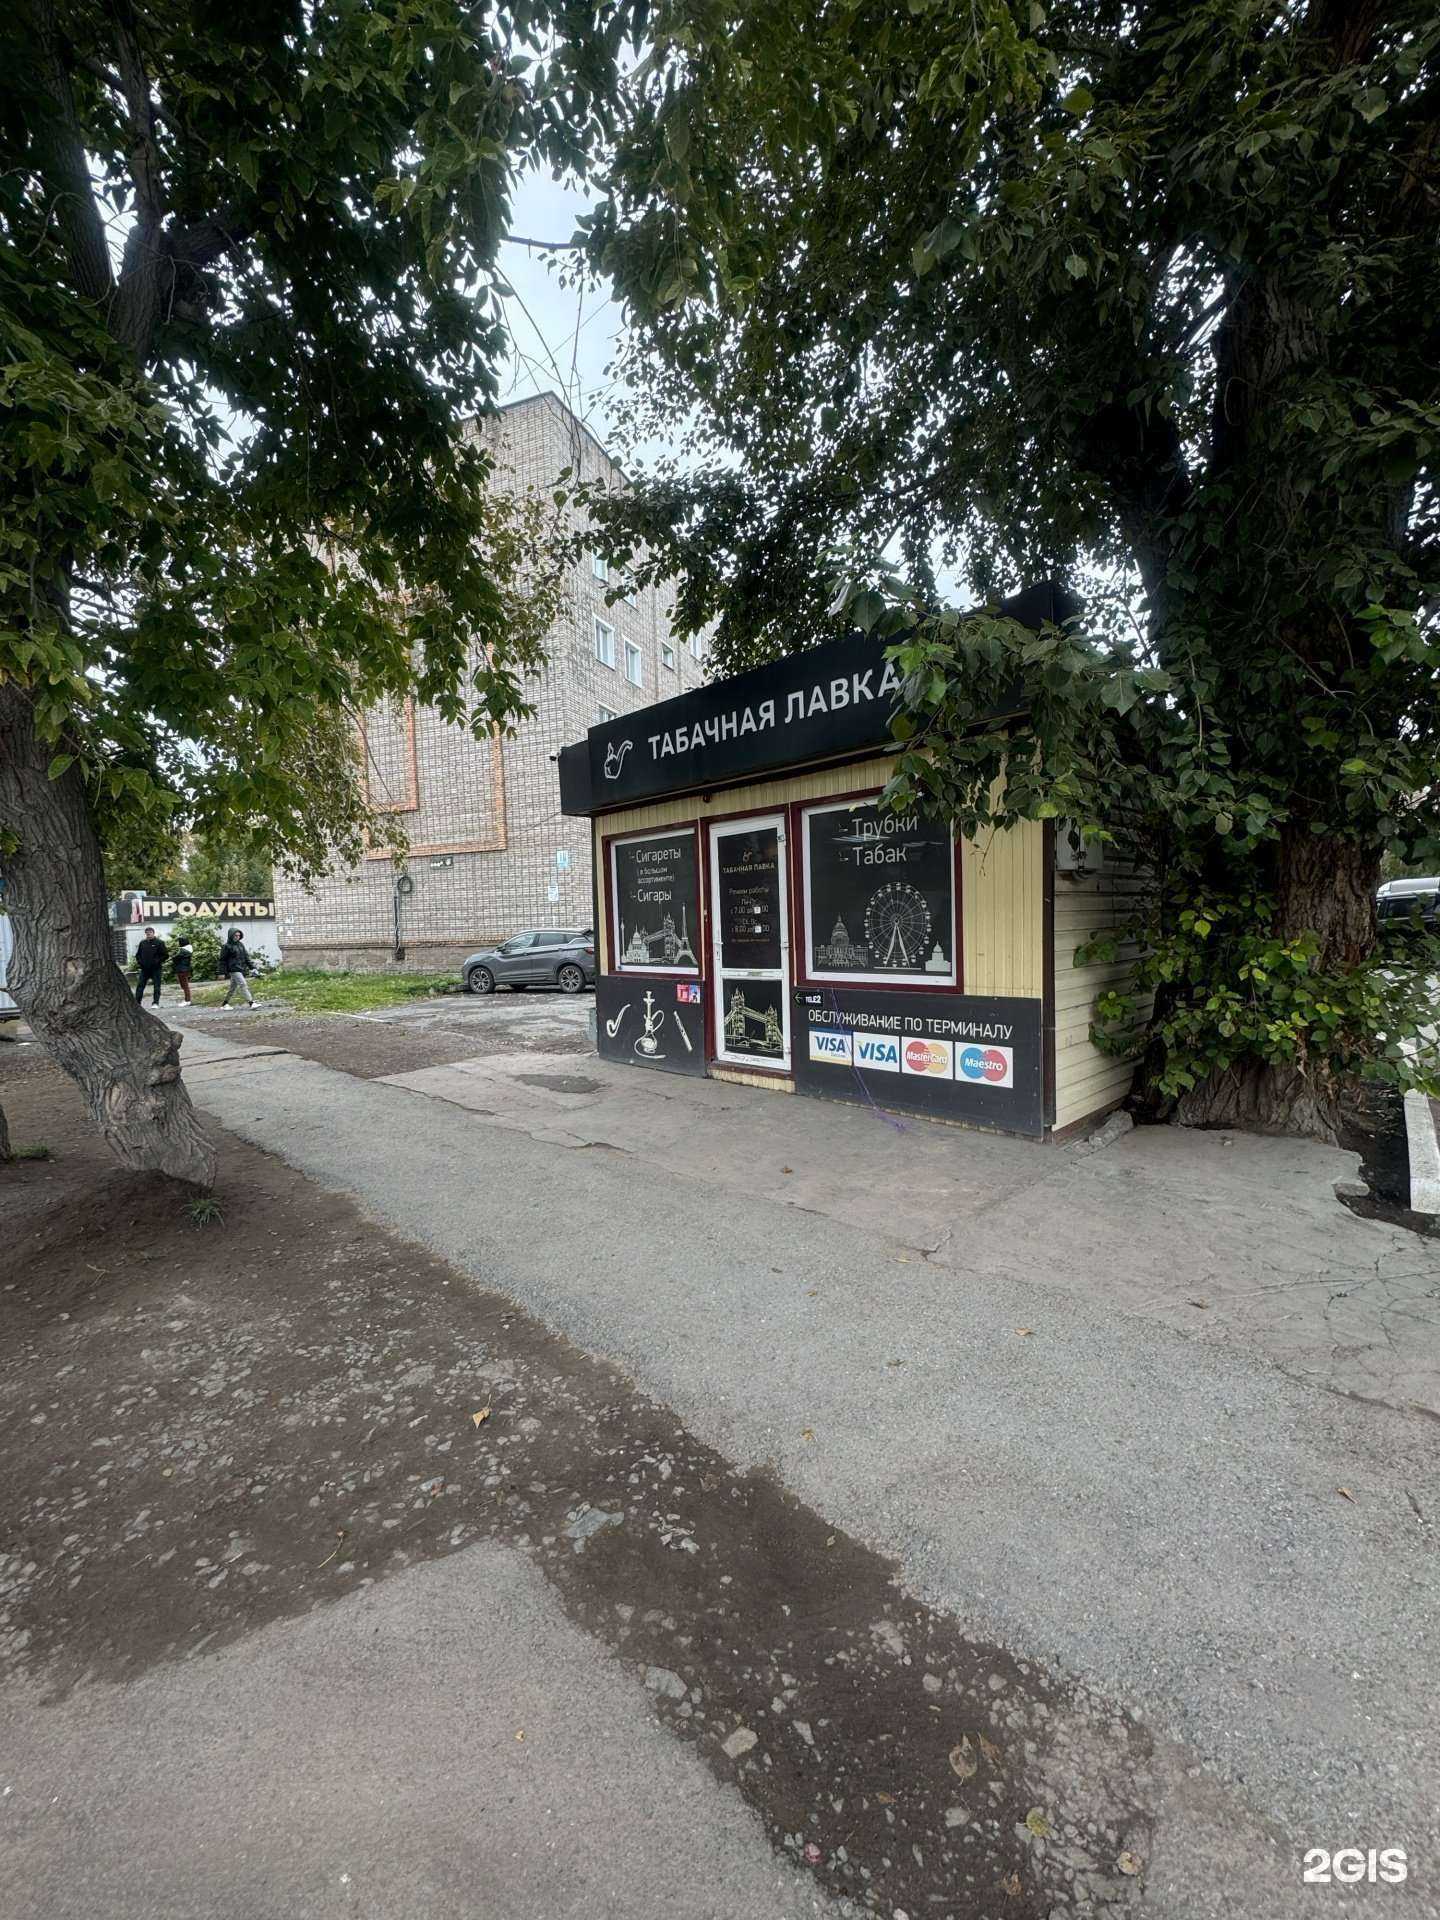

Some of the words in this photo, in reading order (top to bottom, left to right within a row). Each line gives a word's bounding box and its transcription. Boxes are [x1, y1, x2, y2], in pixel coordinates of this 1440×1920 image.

[648, 700, 775, 760] ТАБАЧНАЯ
[784, 663, 900, 724] ЛАВКА
[852, 813, 918, 841] Трубки
[636, 848, 681, 864] Сигареты
[852, 843, 907, 866] Табак
[637, 889, 672, 904] Сигары
[143, 901, 275, 917] ПРОДУКТЫ
[808, 1009, 901, 1030] ОБСЛУЖИВАНИЕ
[904, 1017, 923, 1031] ПО
[926, 1018, 1013, 1040] ТЕРМИНАЛУ
[815, 1035, 846, 1054] VISA
[857, 1040, 898, 1064] VISA
[906, 1049, 948, 1065] MasterCard
[964, 1057, 1004, 1072] Maestro
